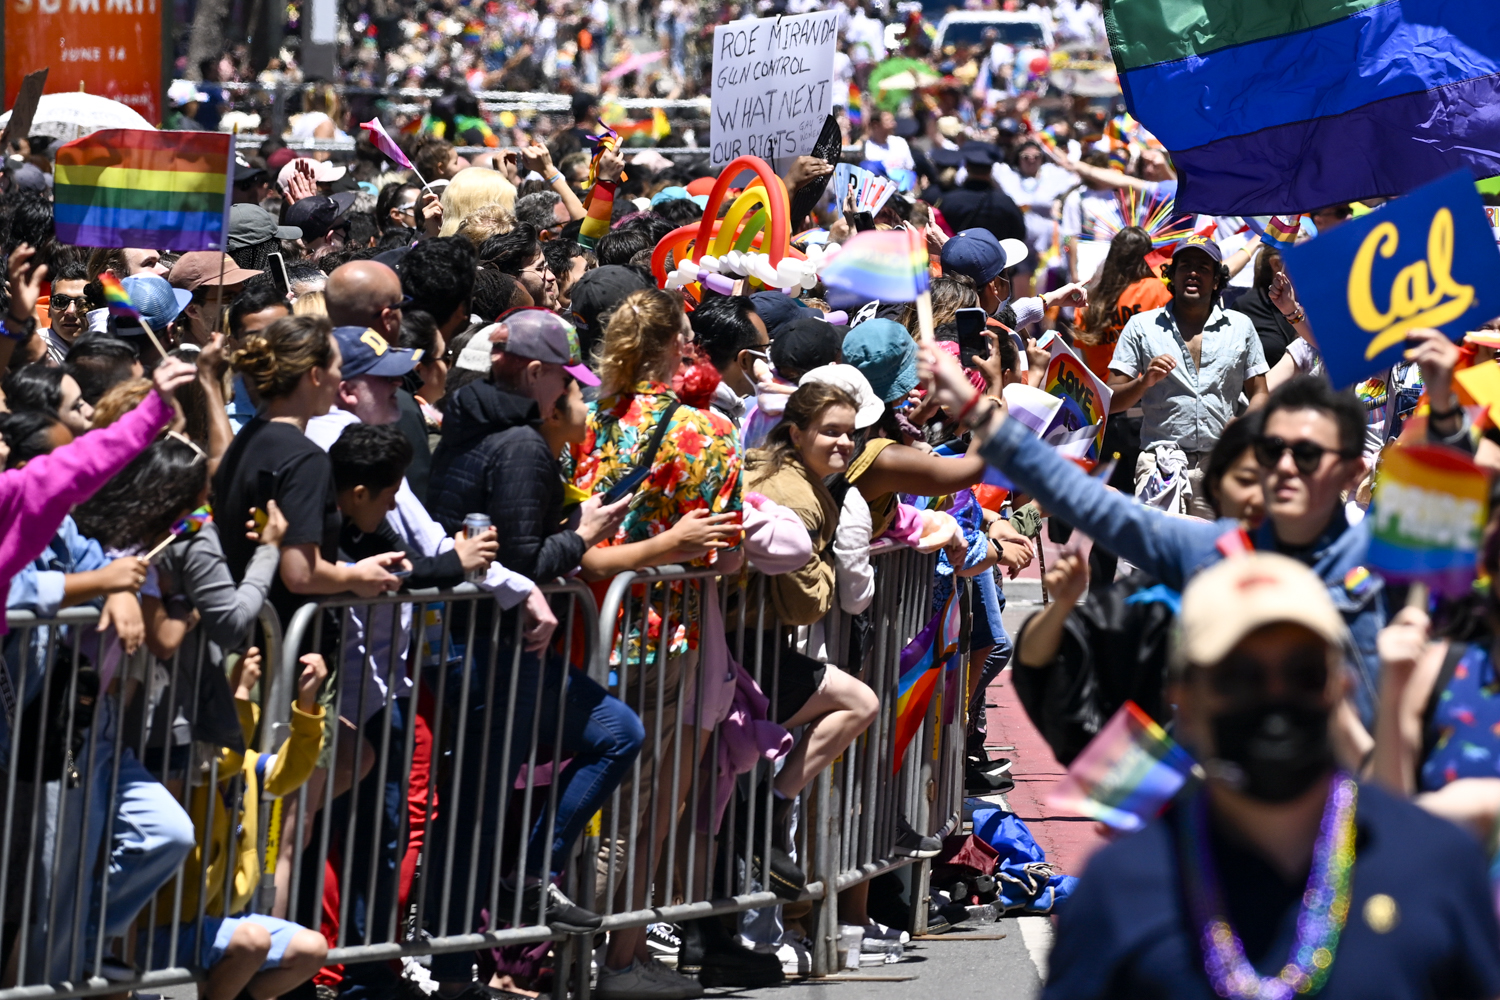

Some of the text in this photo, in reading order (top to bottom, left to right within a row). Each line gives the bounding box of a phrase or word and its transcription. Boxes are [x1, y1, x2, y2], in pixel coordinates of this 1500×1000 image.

[60, 48, 101, 62] JUNE
[721, 15, 837, 60] ROE MIRANDA
[717, 56, 811, 91] GUN CONTROL
[716, 79, 829, 132] WHAT NEXT
[712, 139, 742, 164] OUR
[1347, 207, 1475, 361] Cal
[1057, 360, 1095, 415] LOVE
